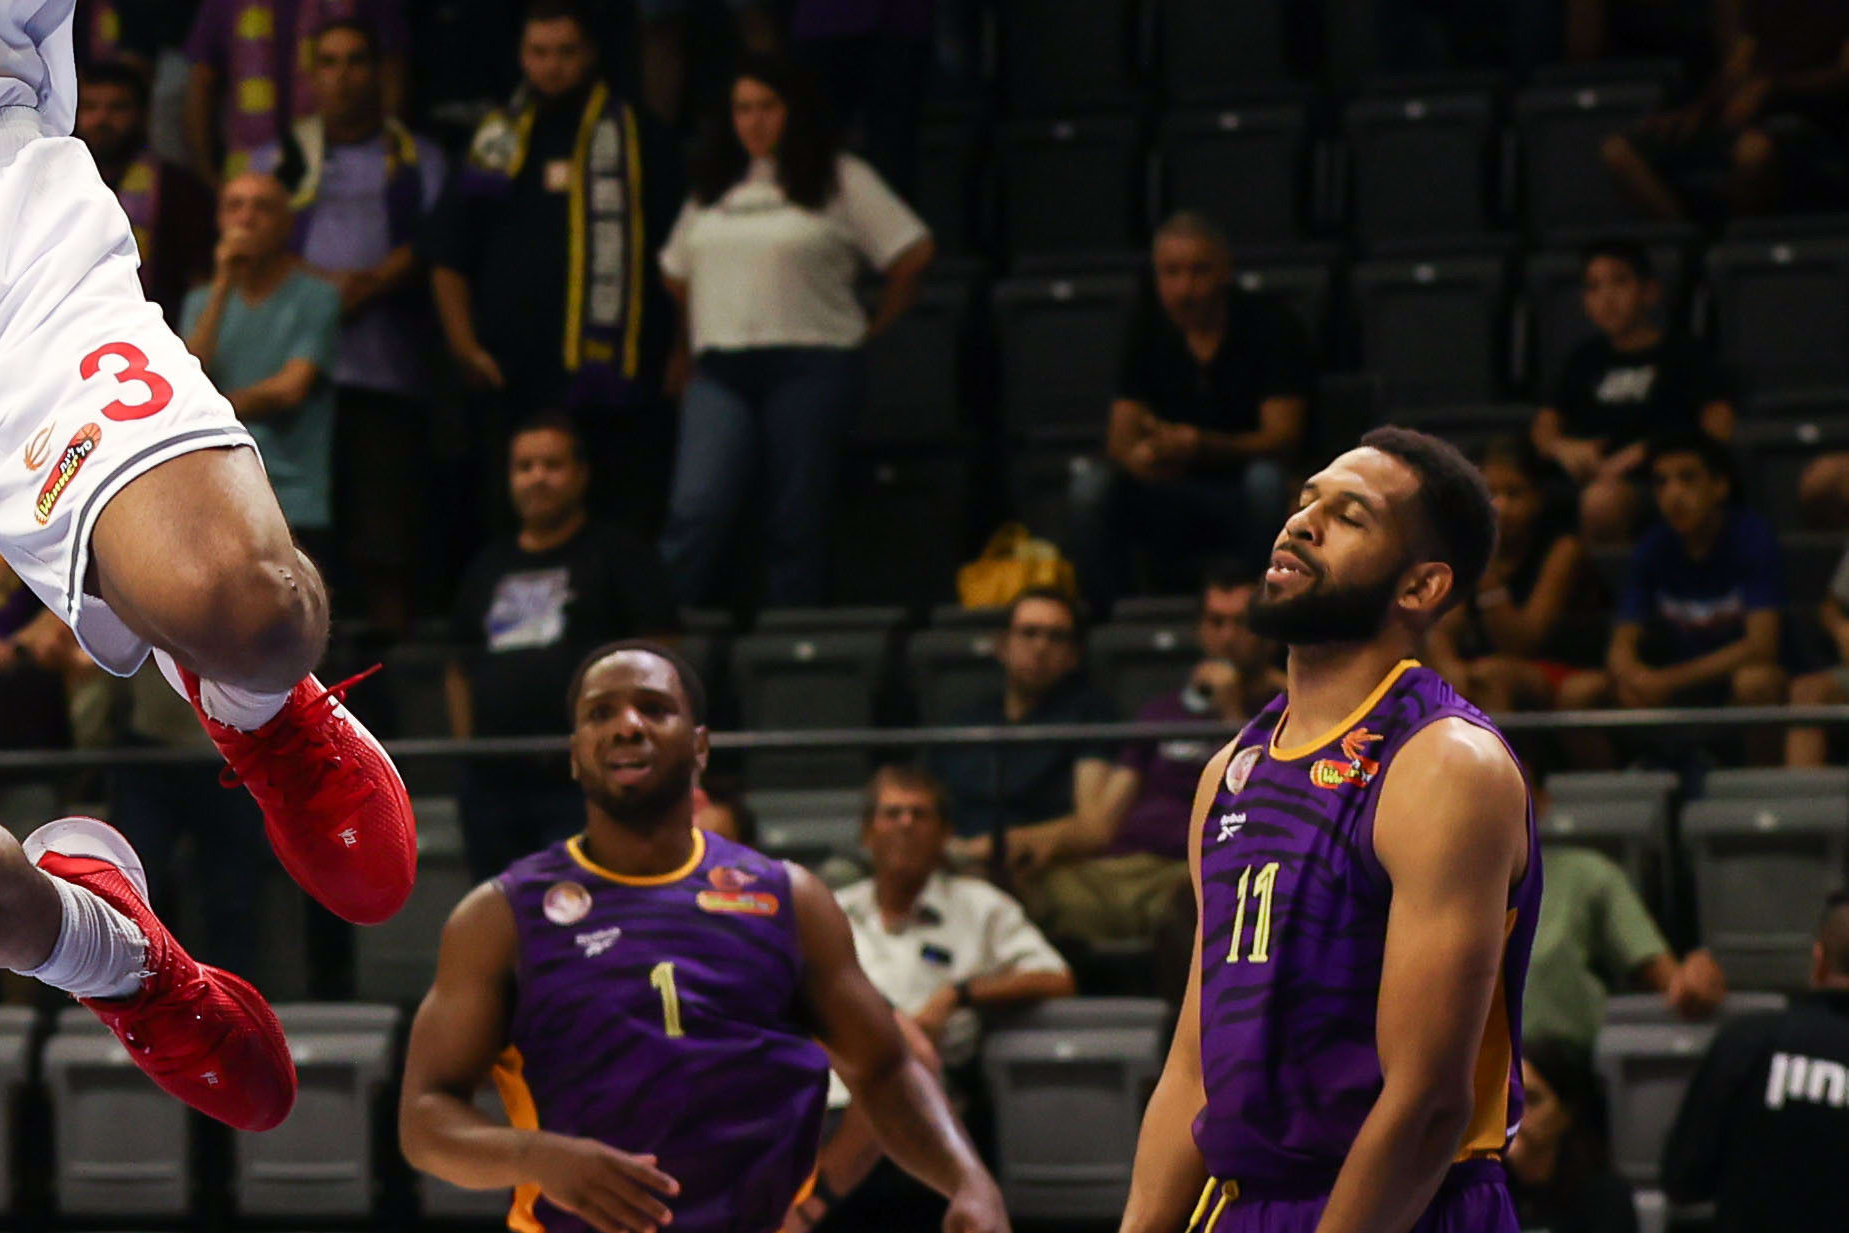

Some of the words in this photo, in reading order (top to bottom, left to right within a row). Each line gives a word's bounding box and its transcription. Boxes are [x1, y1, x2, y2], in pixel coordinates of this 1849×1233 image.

[80, 341, 174, 422] 3
[38, 454, 79, 517] Winner
[1226, 862, 1280, 963] 11
[649, 961, 686, 1038] 1
[1763, 1051, 1849, 1111] חון
